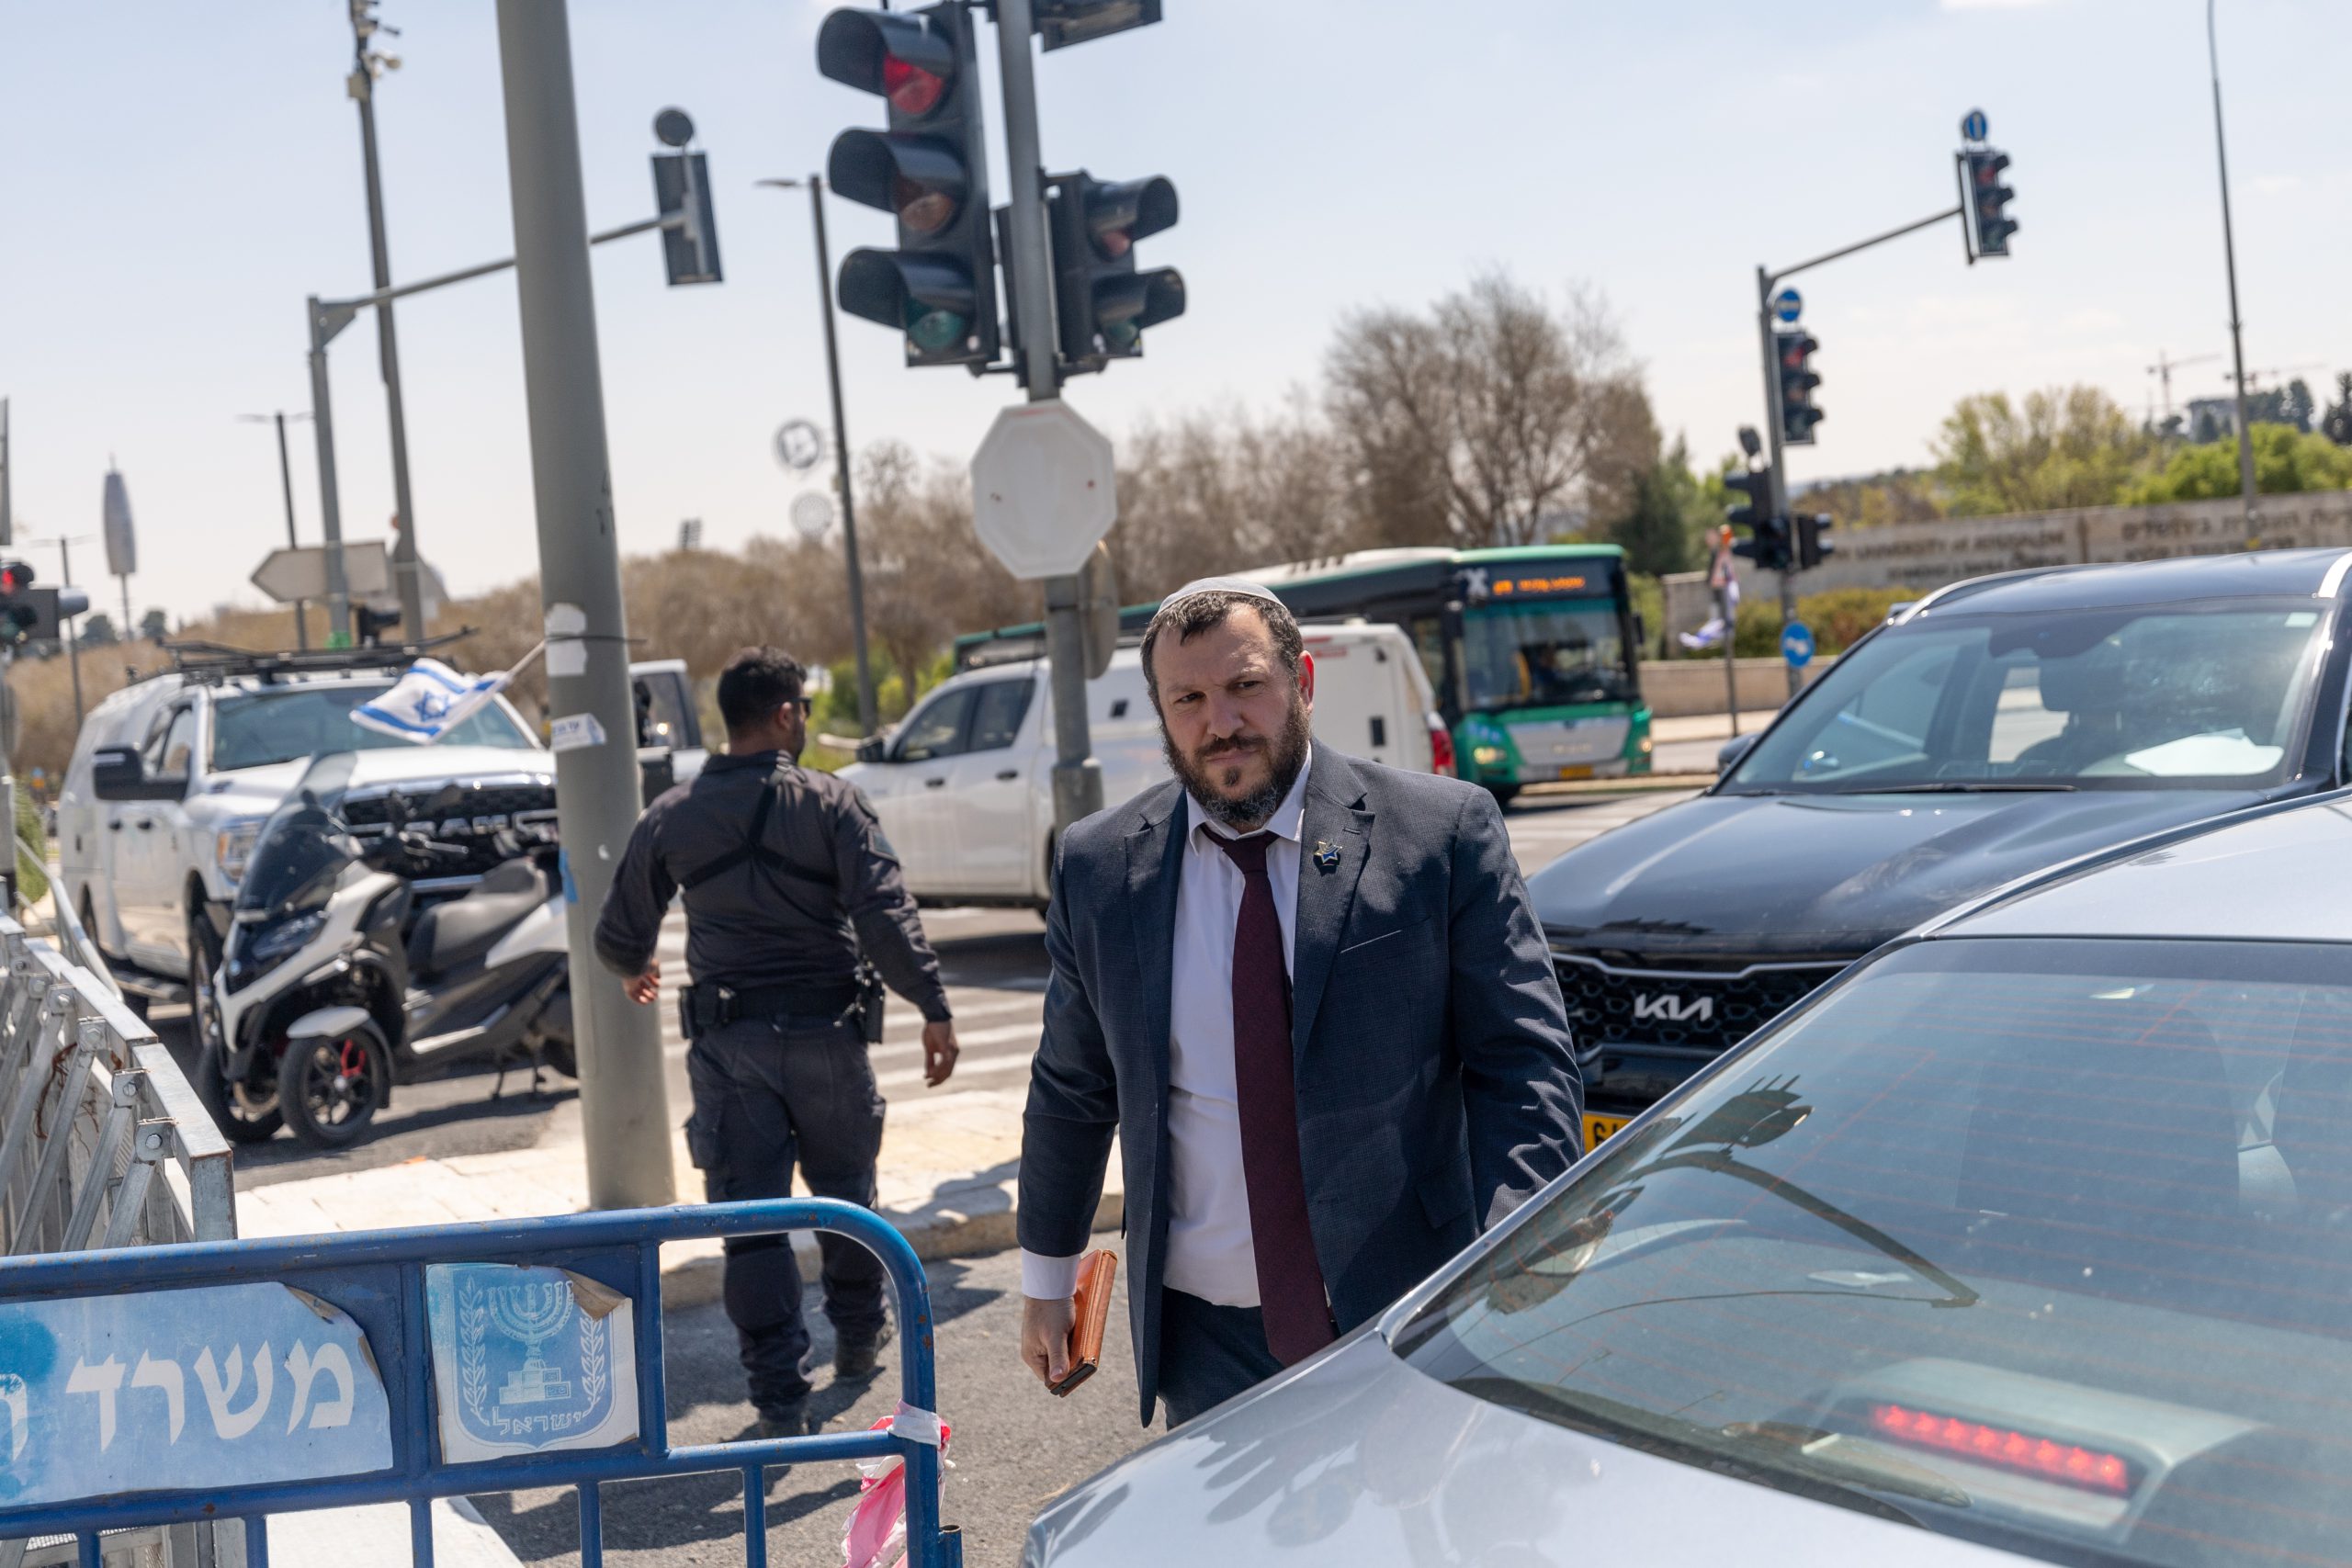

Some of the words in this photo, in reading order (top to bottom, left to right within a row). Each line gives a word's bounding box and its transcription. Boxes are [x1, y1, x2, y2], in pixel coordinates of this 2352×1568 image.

[1634, 993, 1713, 1021] KIA
[66, 1337, 355, 1453] משרד
[492, 1405, 582, 1436] ישראל
